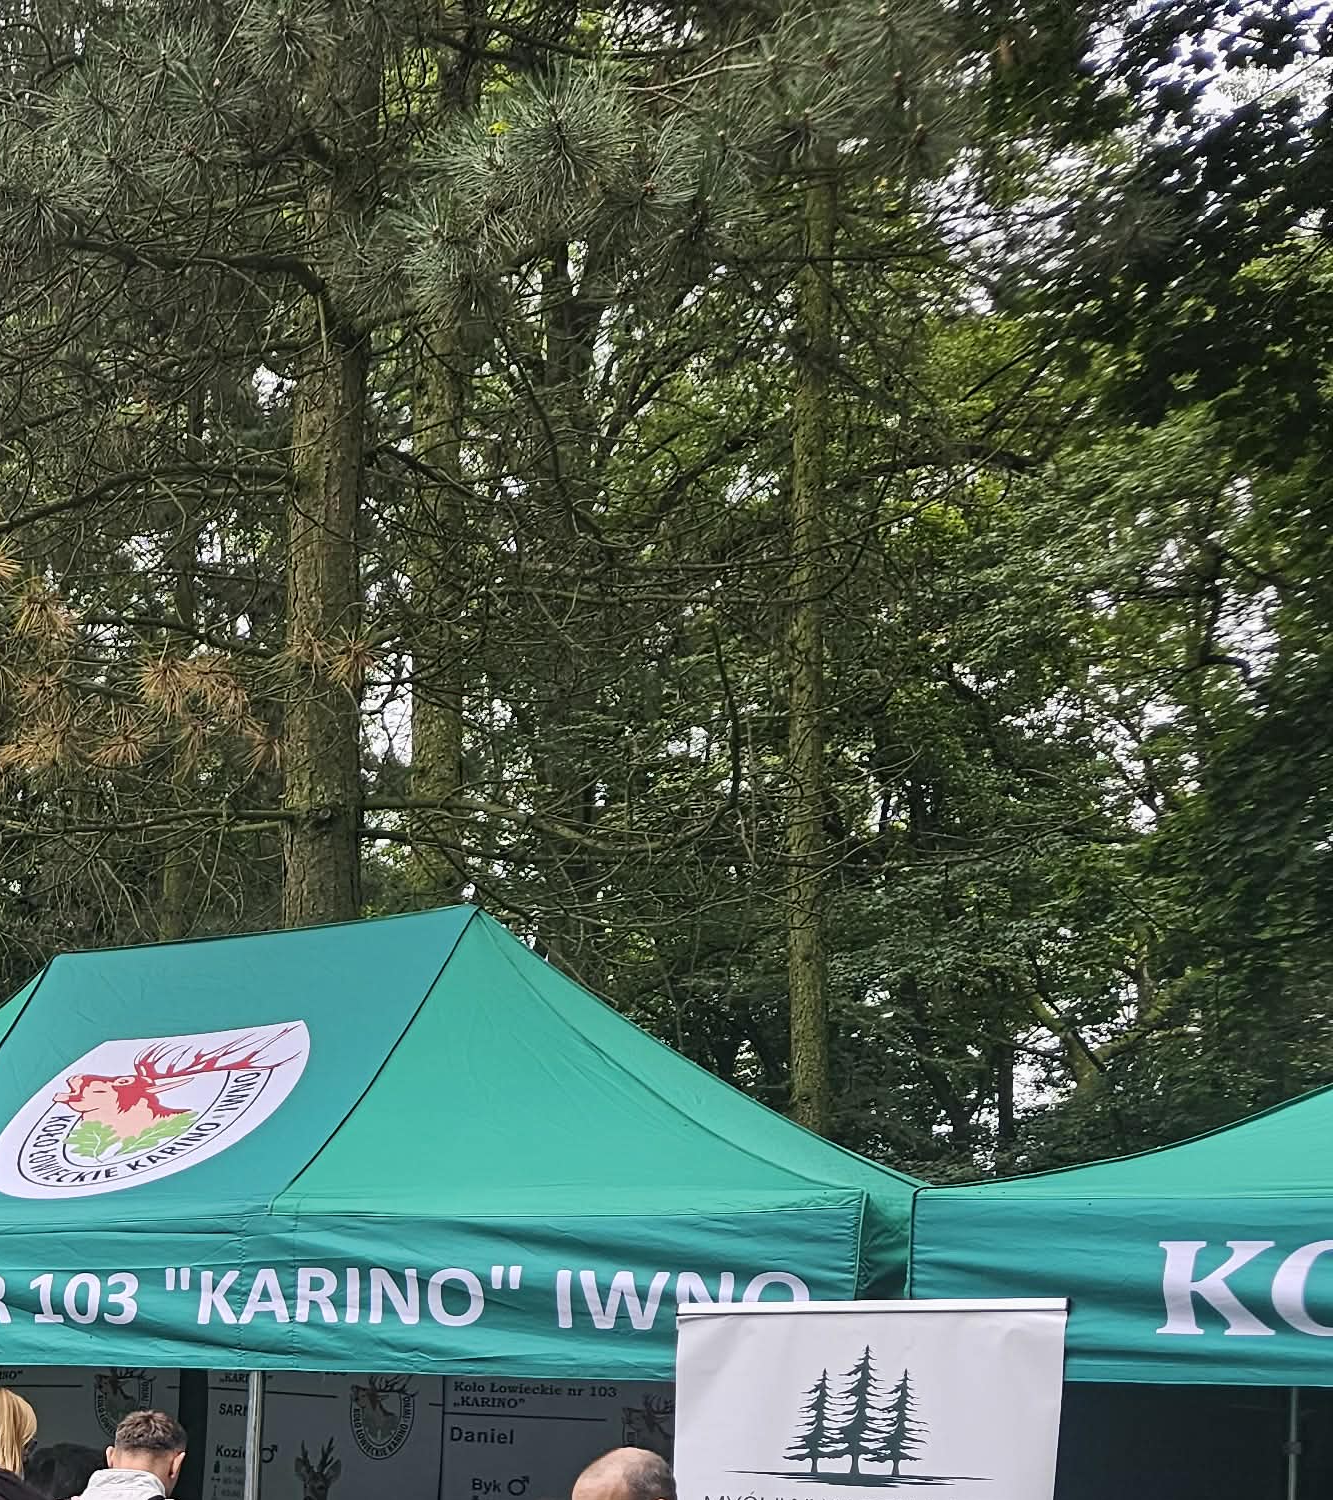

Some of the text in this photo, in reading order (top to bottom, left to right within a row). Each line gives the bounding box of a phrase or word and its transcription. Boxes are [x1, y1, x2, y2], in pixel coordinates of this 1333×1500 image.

[126, 1122, 222, 1172] KARINO
[221, 1071, 262, 1113] IWNO
[29, 1271, 139, 1325] 103
[165, 1265, 523, 1326] "KARINO"
[568, 1387, 585, 1397] nr
[590, 1387, 618, 1398] 103
[450, 1426, 515, 1445] Daniel
[471, 1478, 502, 1495] Byk
